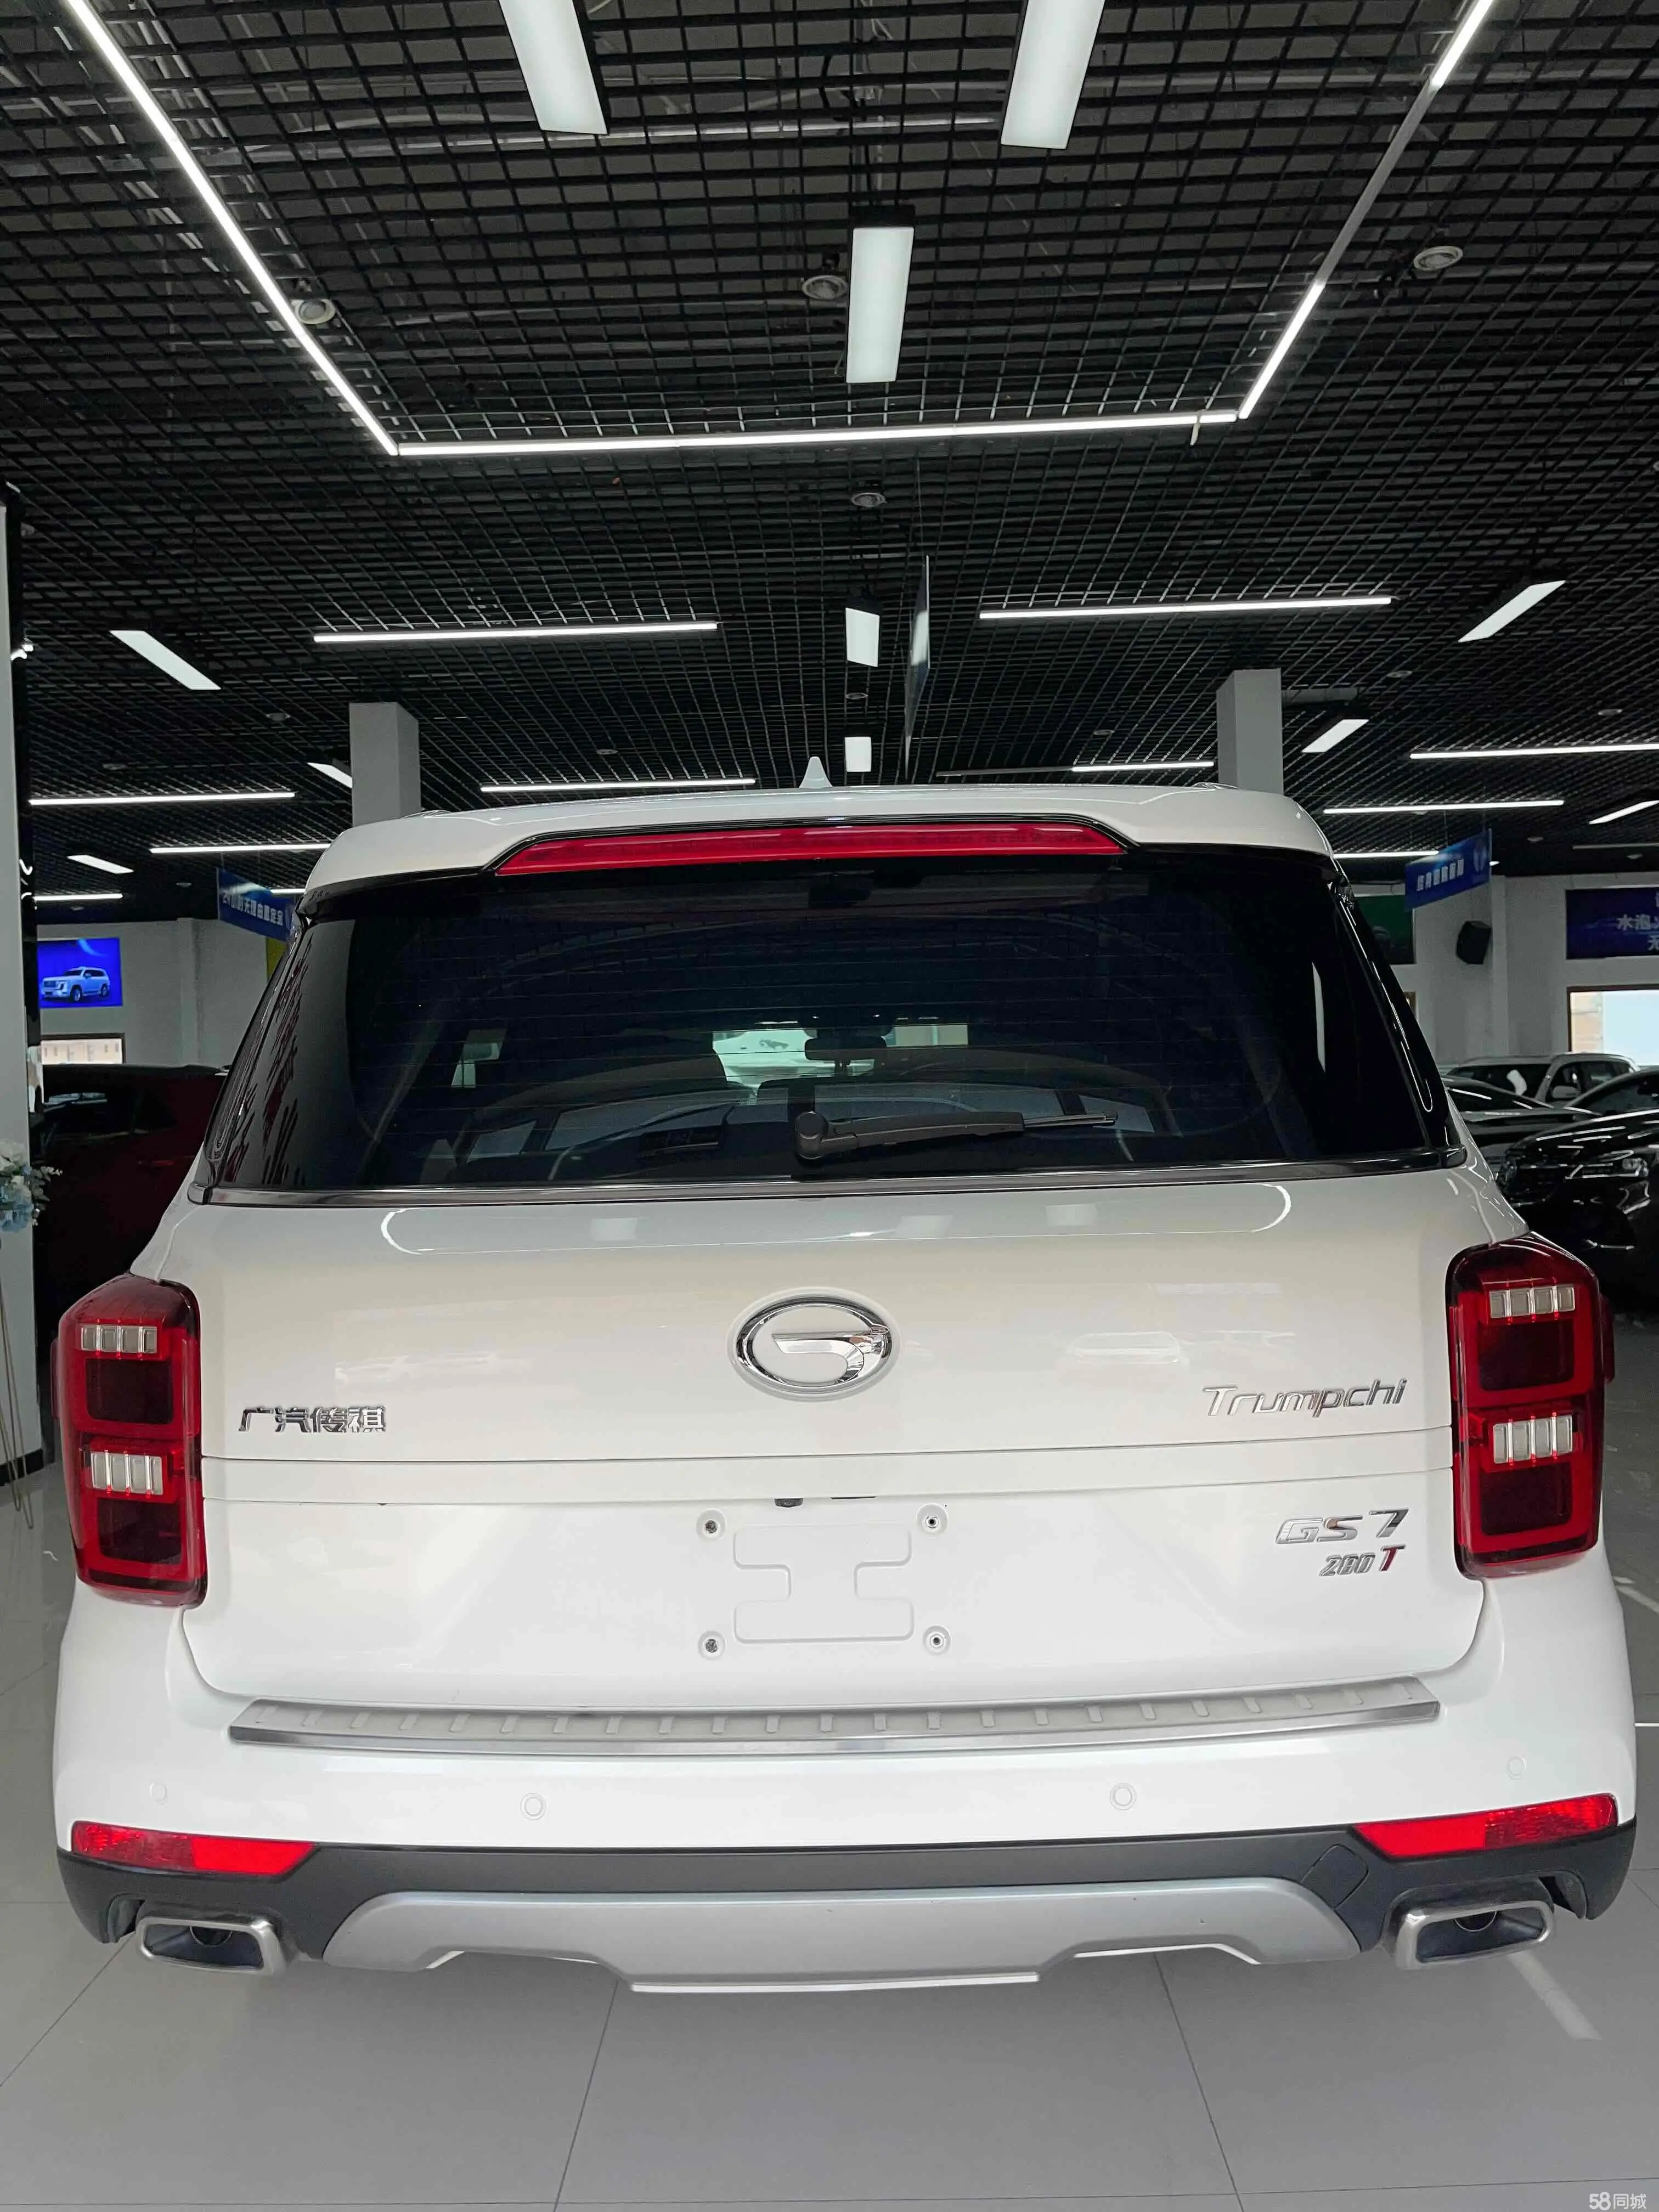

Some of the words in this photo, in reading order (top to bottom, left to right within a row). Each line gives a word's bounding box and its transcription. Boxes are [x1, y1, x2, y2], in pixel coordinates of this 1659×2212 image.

[1202, 1378, 1407, 1418] Trumpchi
[238, 1406, 386, 1433] 广汽传祺
